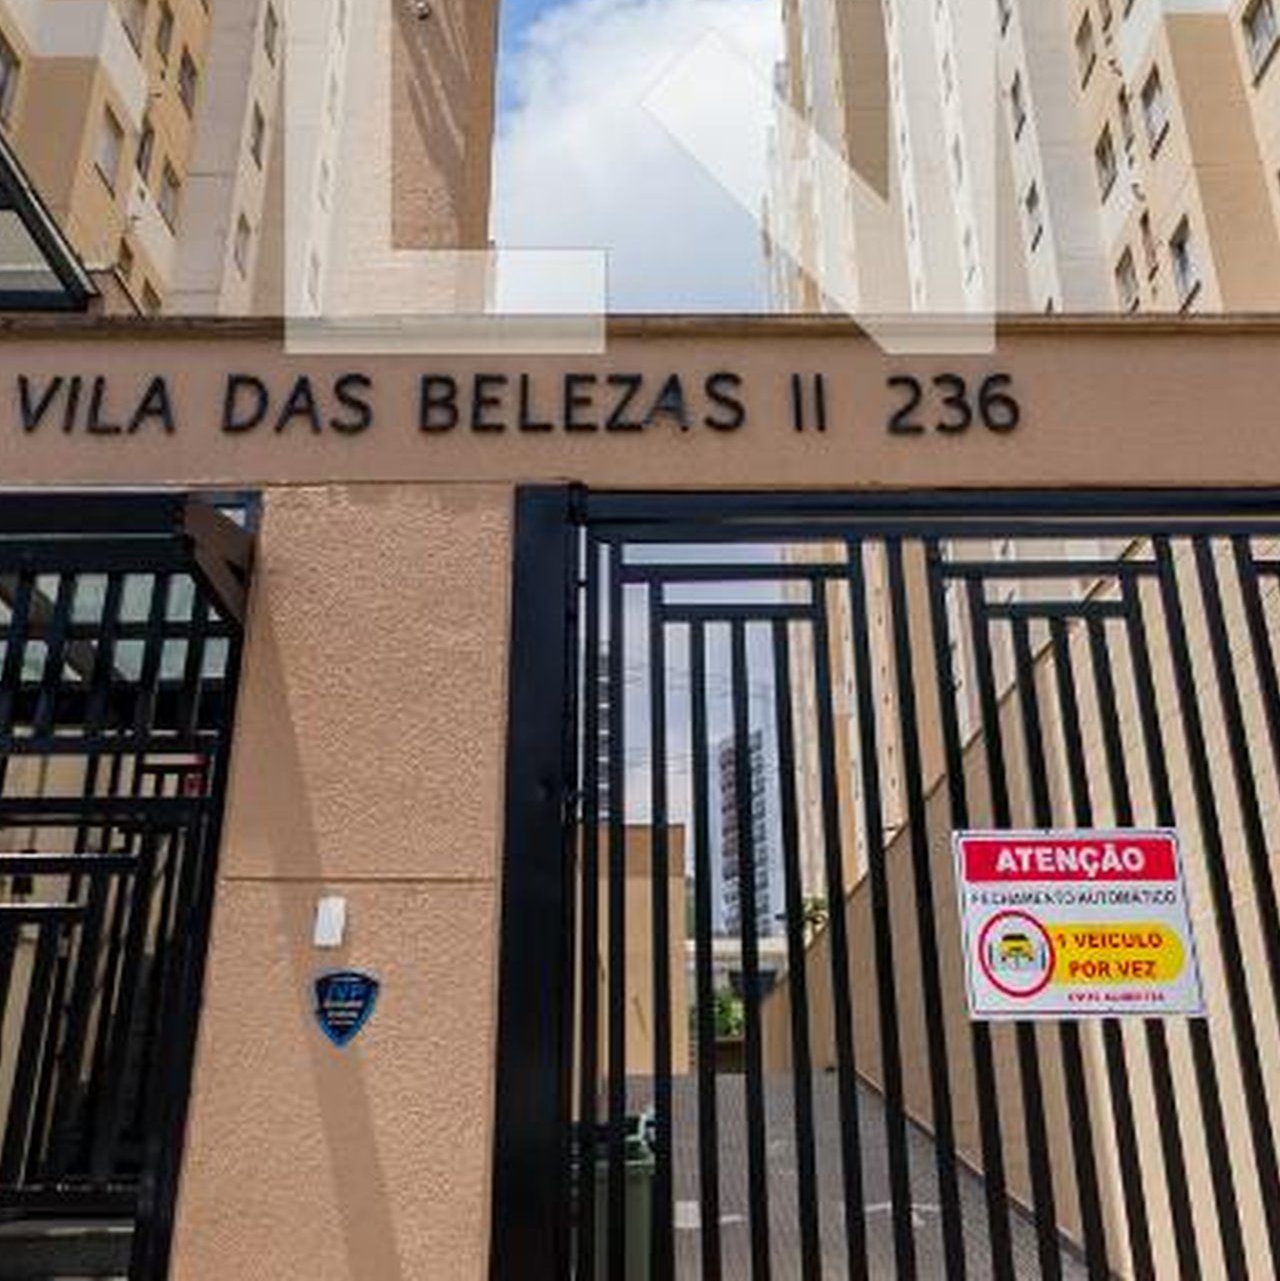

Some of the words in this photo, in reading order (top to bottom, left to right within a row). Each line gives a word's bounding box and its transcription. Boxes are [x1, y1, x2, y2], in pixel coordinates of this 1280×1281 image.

[17, 375, 176, 436] VILA
[220, 373, 374, 436] DAS
[419, 372, 746, 434] BELEZAS
[886, 373, 1021, 436] 236
[996, 843, 1145, 878] ATENÇÃO
[1069, 960, 1111, 979] POR
[1118, 960, 1156, 979] VEZ
